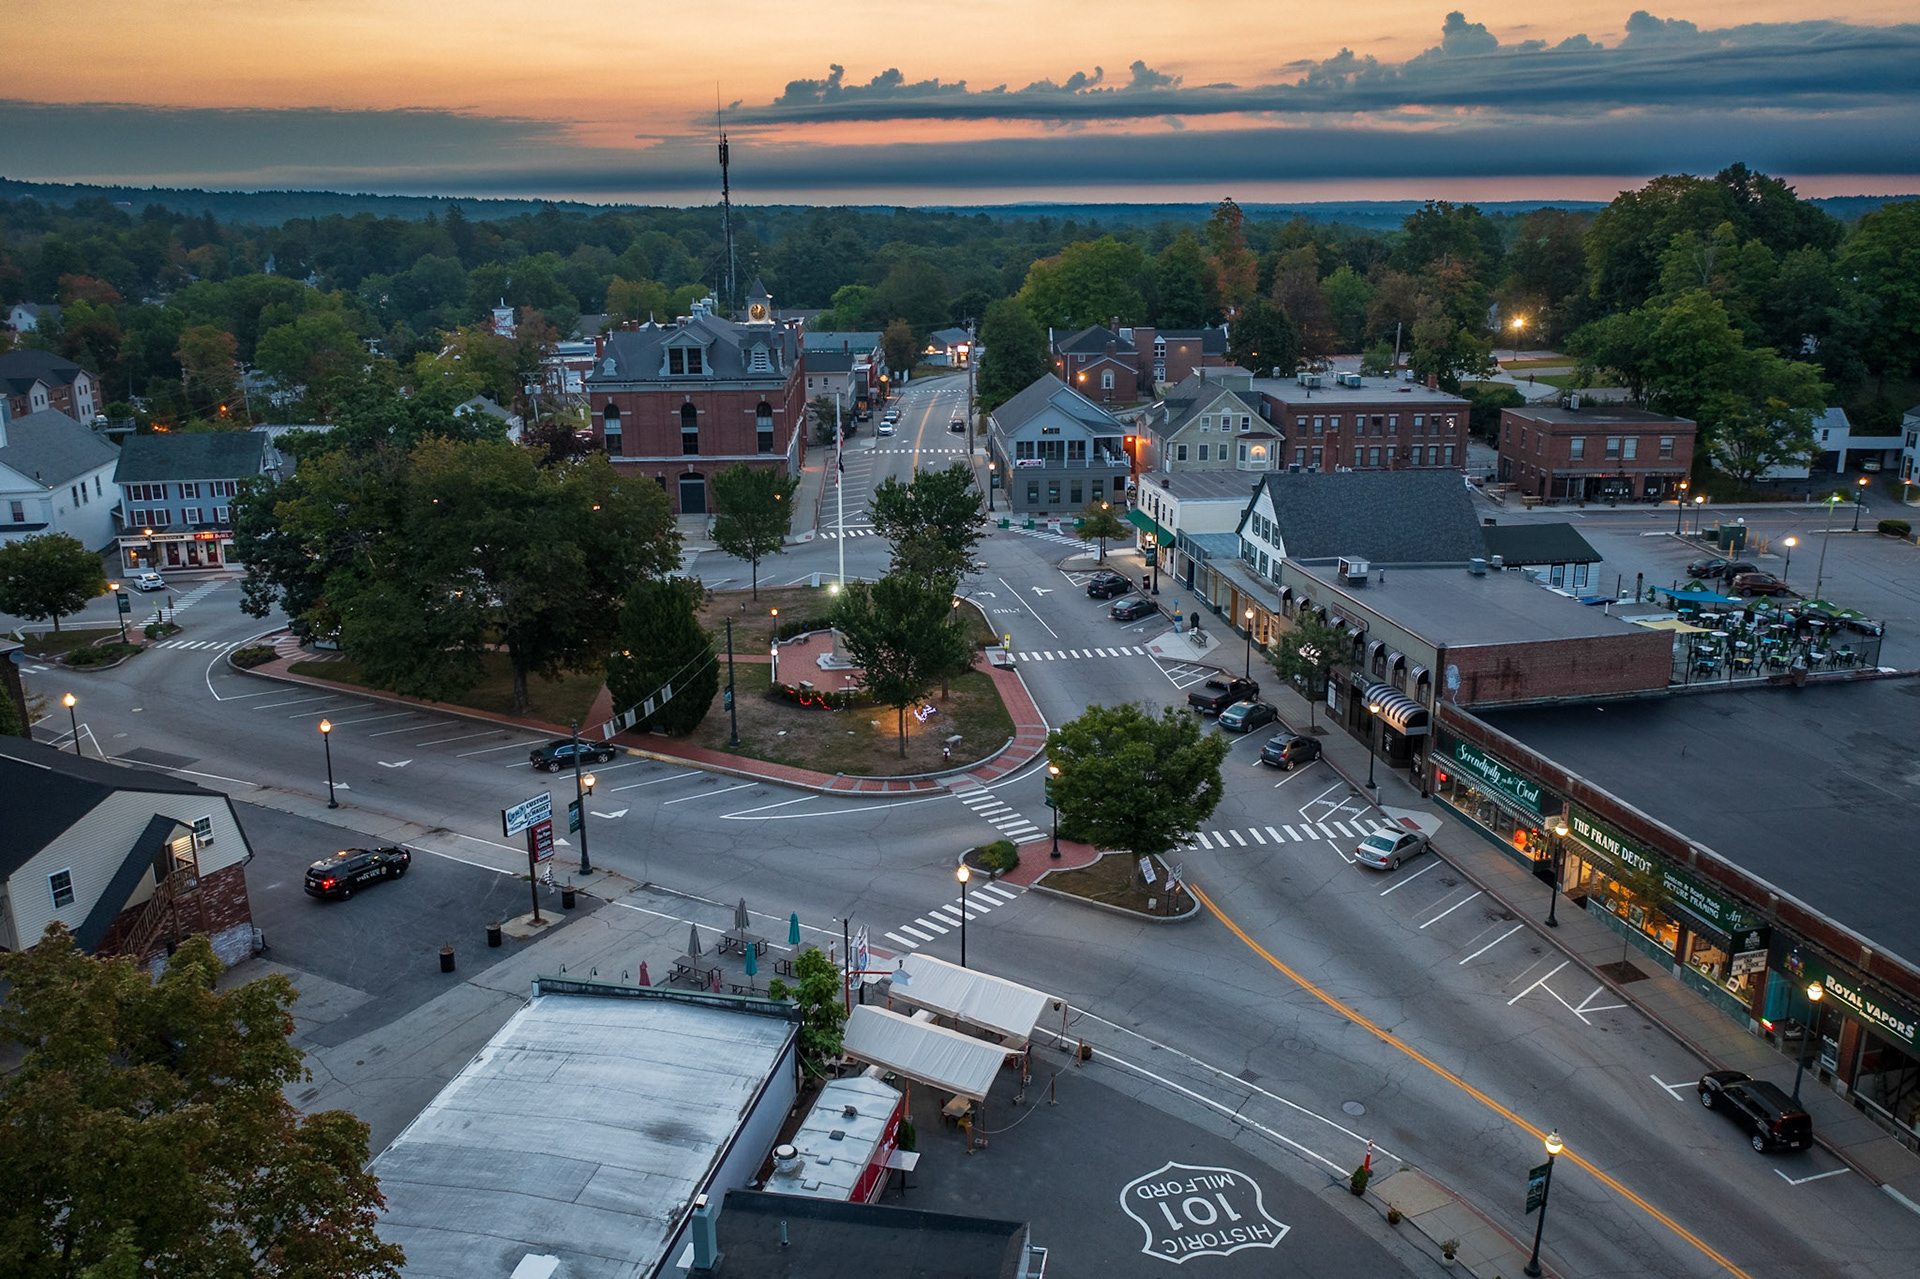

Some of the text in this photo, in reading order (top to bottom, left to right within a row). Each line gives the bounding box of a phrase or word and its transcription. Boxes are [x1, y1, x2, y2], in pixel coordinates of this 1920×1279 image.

[1457, 744, 1502, 785] Serendipity
[524, 804, 549, 819] EXHAUST
[526, 794, 549, 809] CUSTOM
[1573, 817, 1652, 875] THE FRAME DEPOT
[1663, 871, 1683, 887] Custom
[1663, 880, 1719, 919] PICTURE FRAMING
[1825, 974, 1915, 1039] ROYAL VAPORS
[1137, 1173, 1236, 1199] MILFORD
[1158, 1192, 1242, 1231] 101
[1162, 1223, 1273, 1254] HISTORIC
